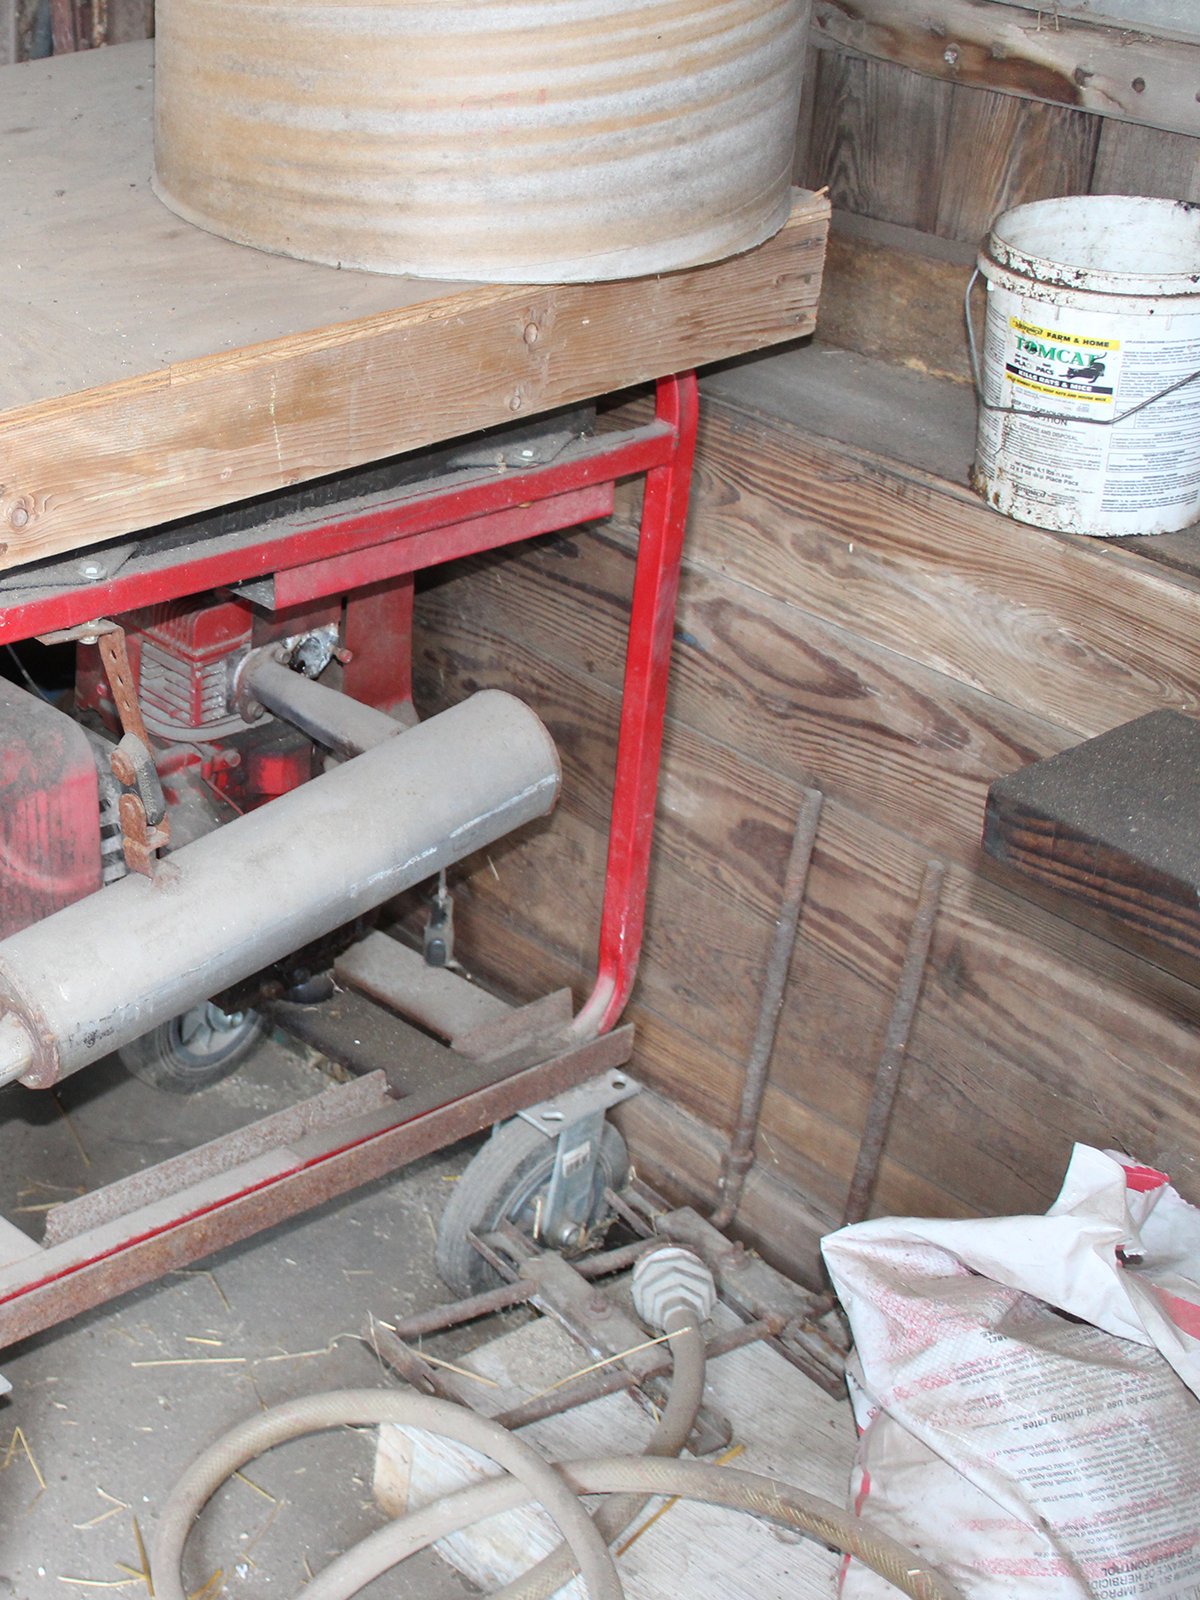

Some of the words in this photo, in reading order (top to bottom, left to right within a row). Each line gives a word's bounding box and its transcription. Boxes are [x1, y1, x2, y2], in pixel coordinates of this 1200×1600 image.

[1047, 332, 1071, 342] FARM
[1083, 339, 1110, 348] HOME
[1014, 335, 1100, 366] TOMCAT
[1039, 376, 1060, 387] RATS
[1070, 383, 1093, 392] MICE
[1106, 1398, 1124, 1409] use
[1049, 1407, 1085, 1425] mixing
[1100, 1556, 1151, 1578] CONTROL
[1088, 1570, 1143, 1593] HERBICID
